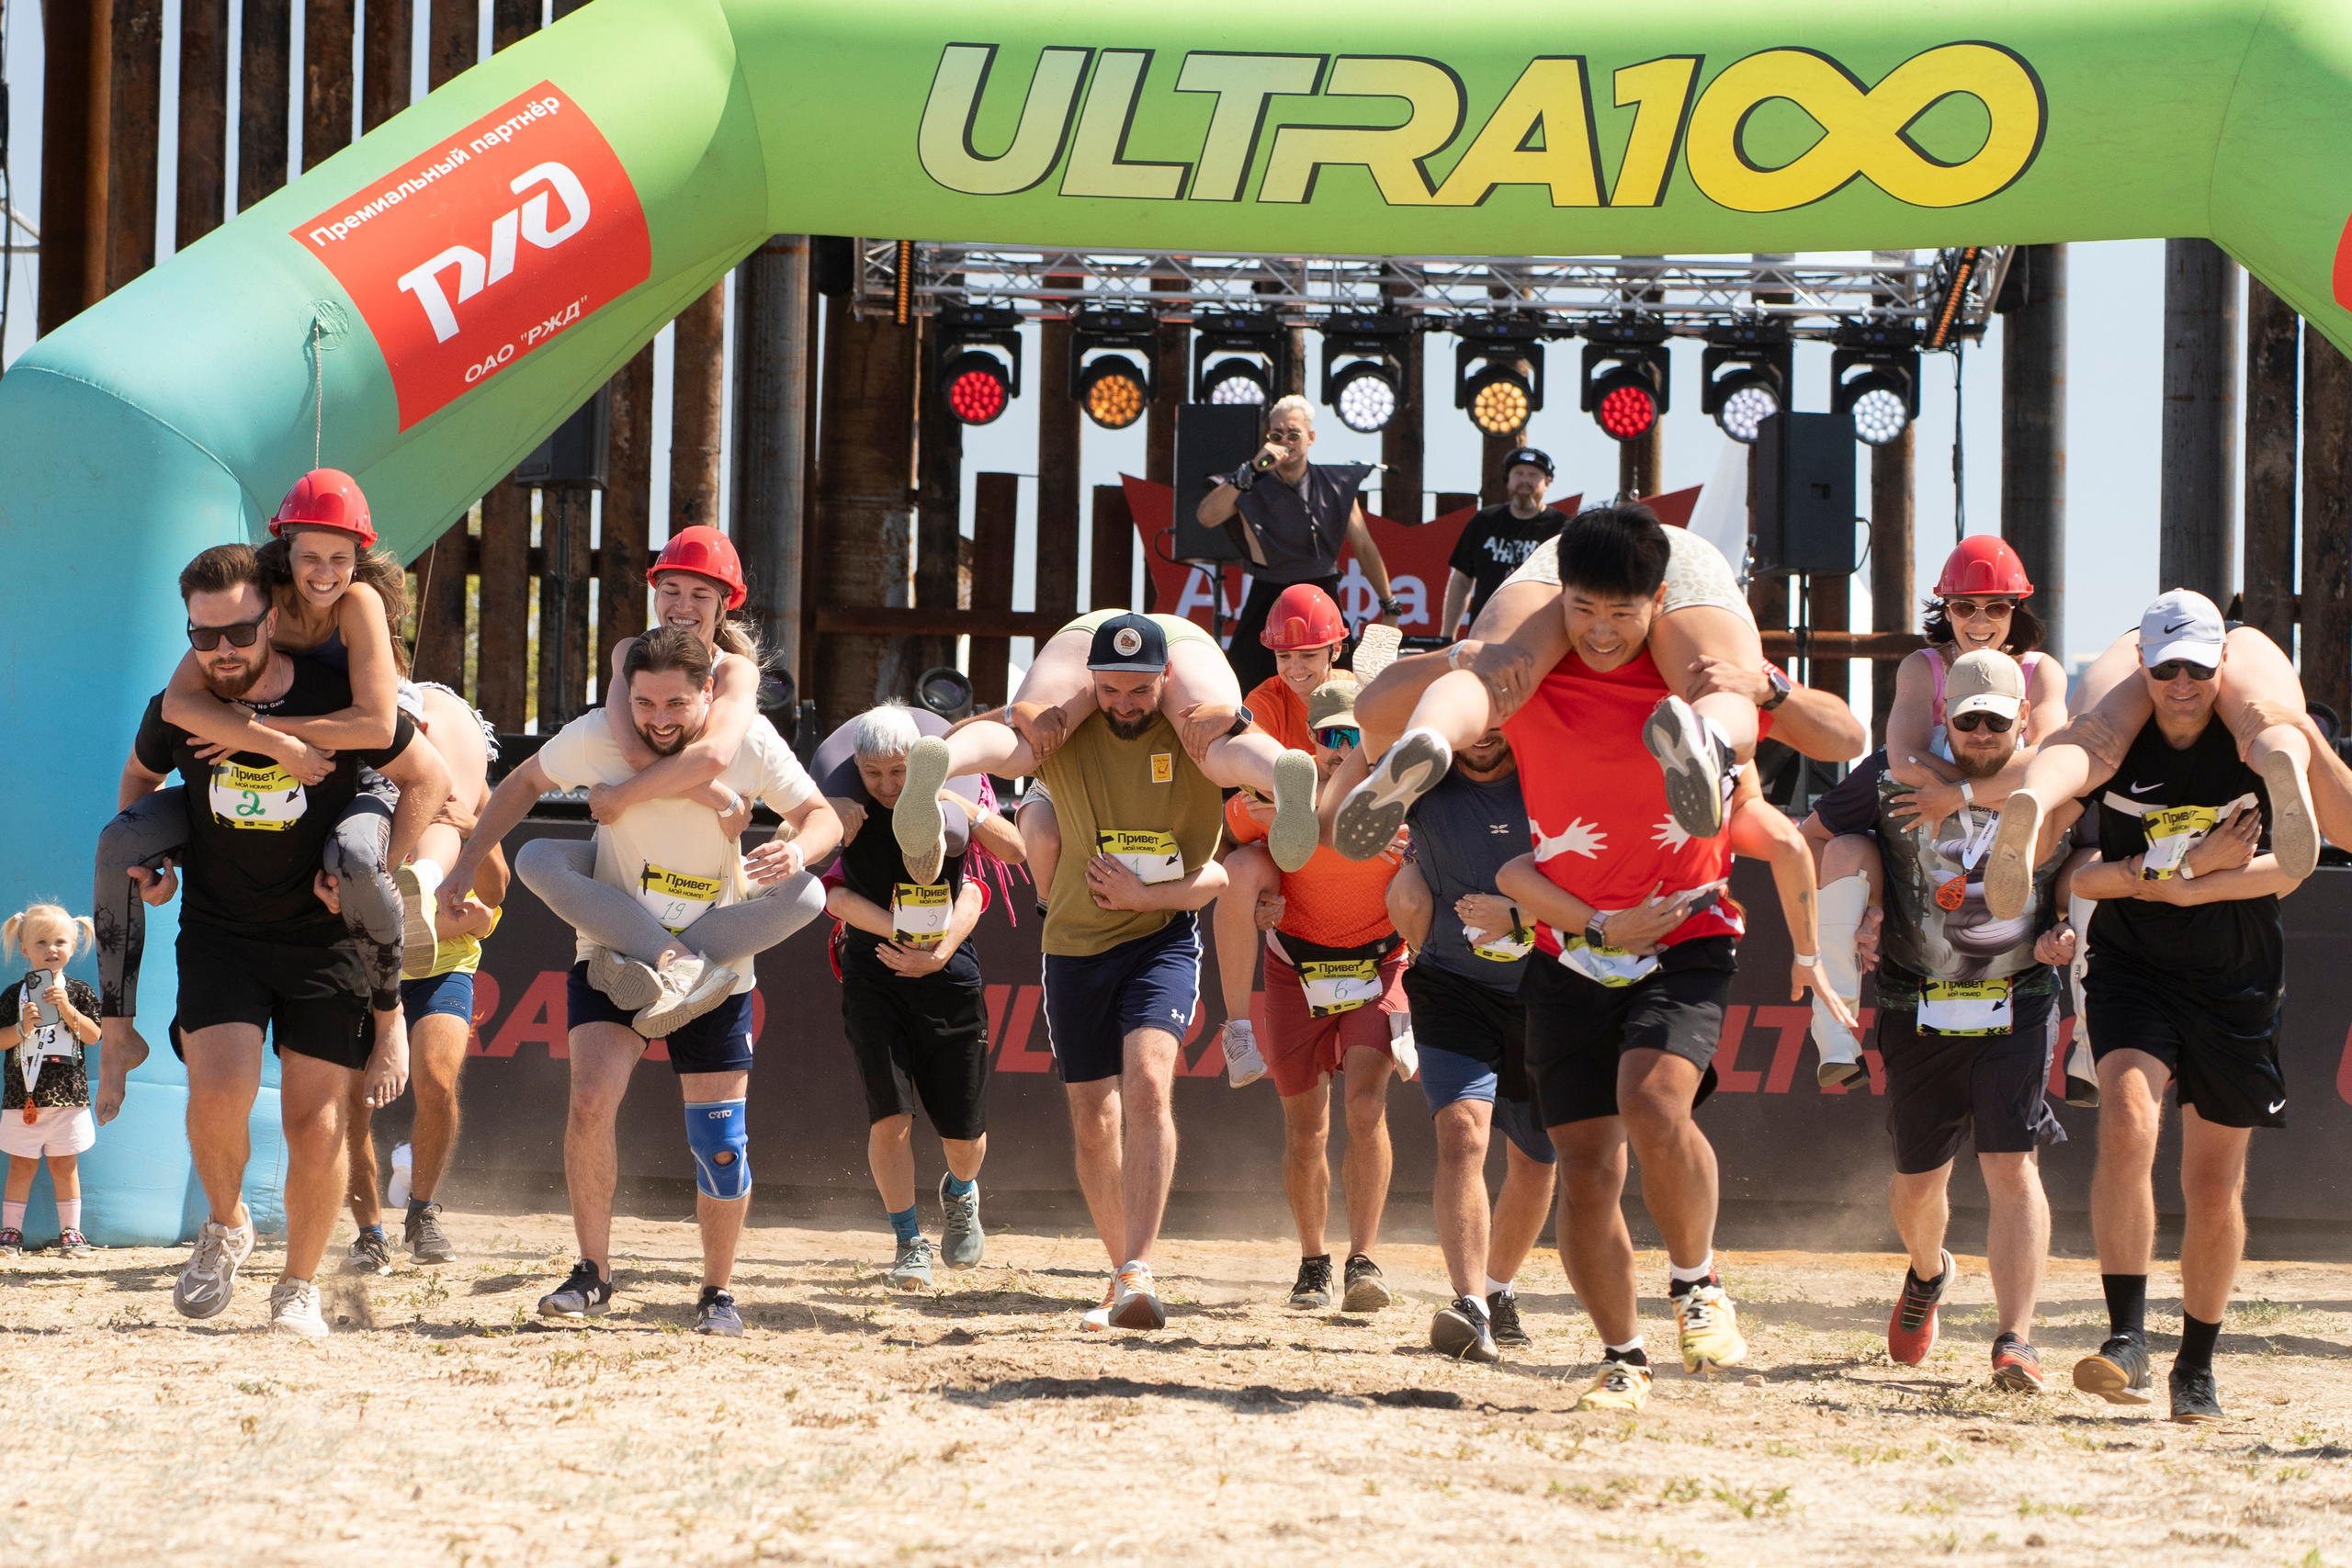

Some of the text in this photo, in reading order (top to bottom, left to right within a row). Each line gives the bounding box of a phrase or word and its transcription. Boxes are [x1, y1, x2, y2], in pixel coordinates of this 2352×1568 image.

[309, 95, 560, 247] Премиальный партнёр
[464, 295, 588, 383] ОАО "РЖД"
[269, 699, 285, 708] Gain
[231, 766, 277, 781] Привет
[235, 790, 266, 817] 2
[1117, 833, 1159, 845] Привет
[1130, 856, 1141, 876] 1
[665, 873, 712, 892] Привет
[668, 887, 704, 899] мой номер
[915, 886, 949, 899] Приве
[660, 901, 686, 919] 19
[927, 908, 938, 927] 3
[1319, 963, 1360, 974] Привет
[1334, 979, 1349, 999] 6
